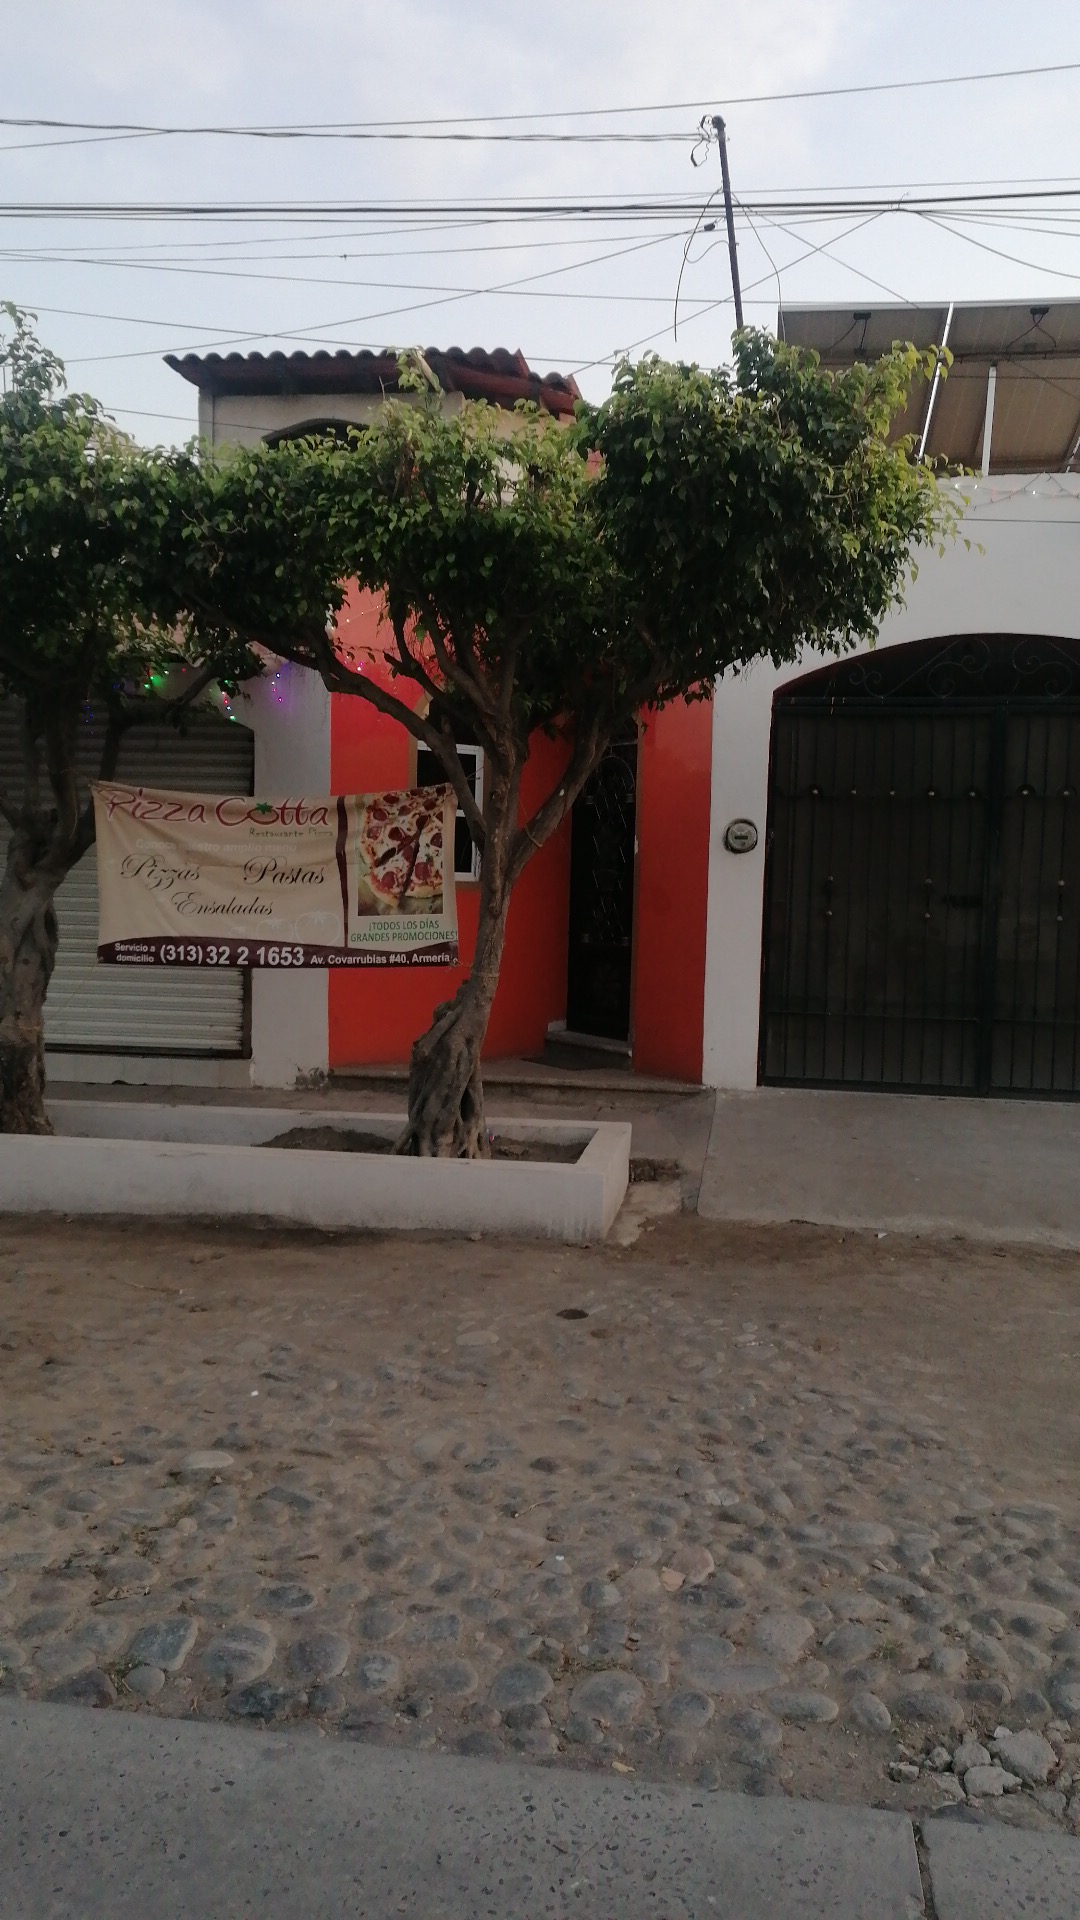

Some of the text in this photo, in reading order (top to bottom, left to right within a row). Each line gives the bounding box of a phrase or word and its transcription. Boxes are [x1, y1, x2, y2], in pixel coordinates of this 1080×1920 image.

[97, 788, 328, 826] Pizza Cotta
[120, 854, 325, 890] Pizzas Pastas
[171, 892, 273, 916] Ensaladas
[368, 918, 440, 932] ¡TODOS LOS DÍAS
[350, 930, 458, 943] GRANDES PROMOCIONES!
[114, 942, 148, 952] Servicio
[116, 953, 155, 963] domicilio
[160, 944, 304, 966] (313) 32 2 1653
[310, 954, 326, 965] Av.
[327, 953, 387, 965] Covarrubias
[412, 952, 450, 964] Armería
